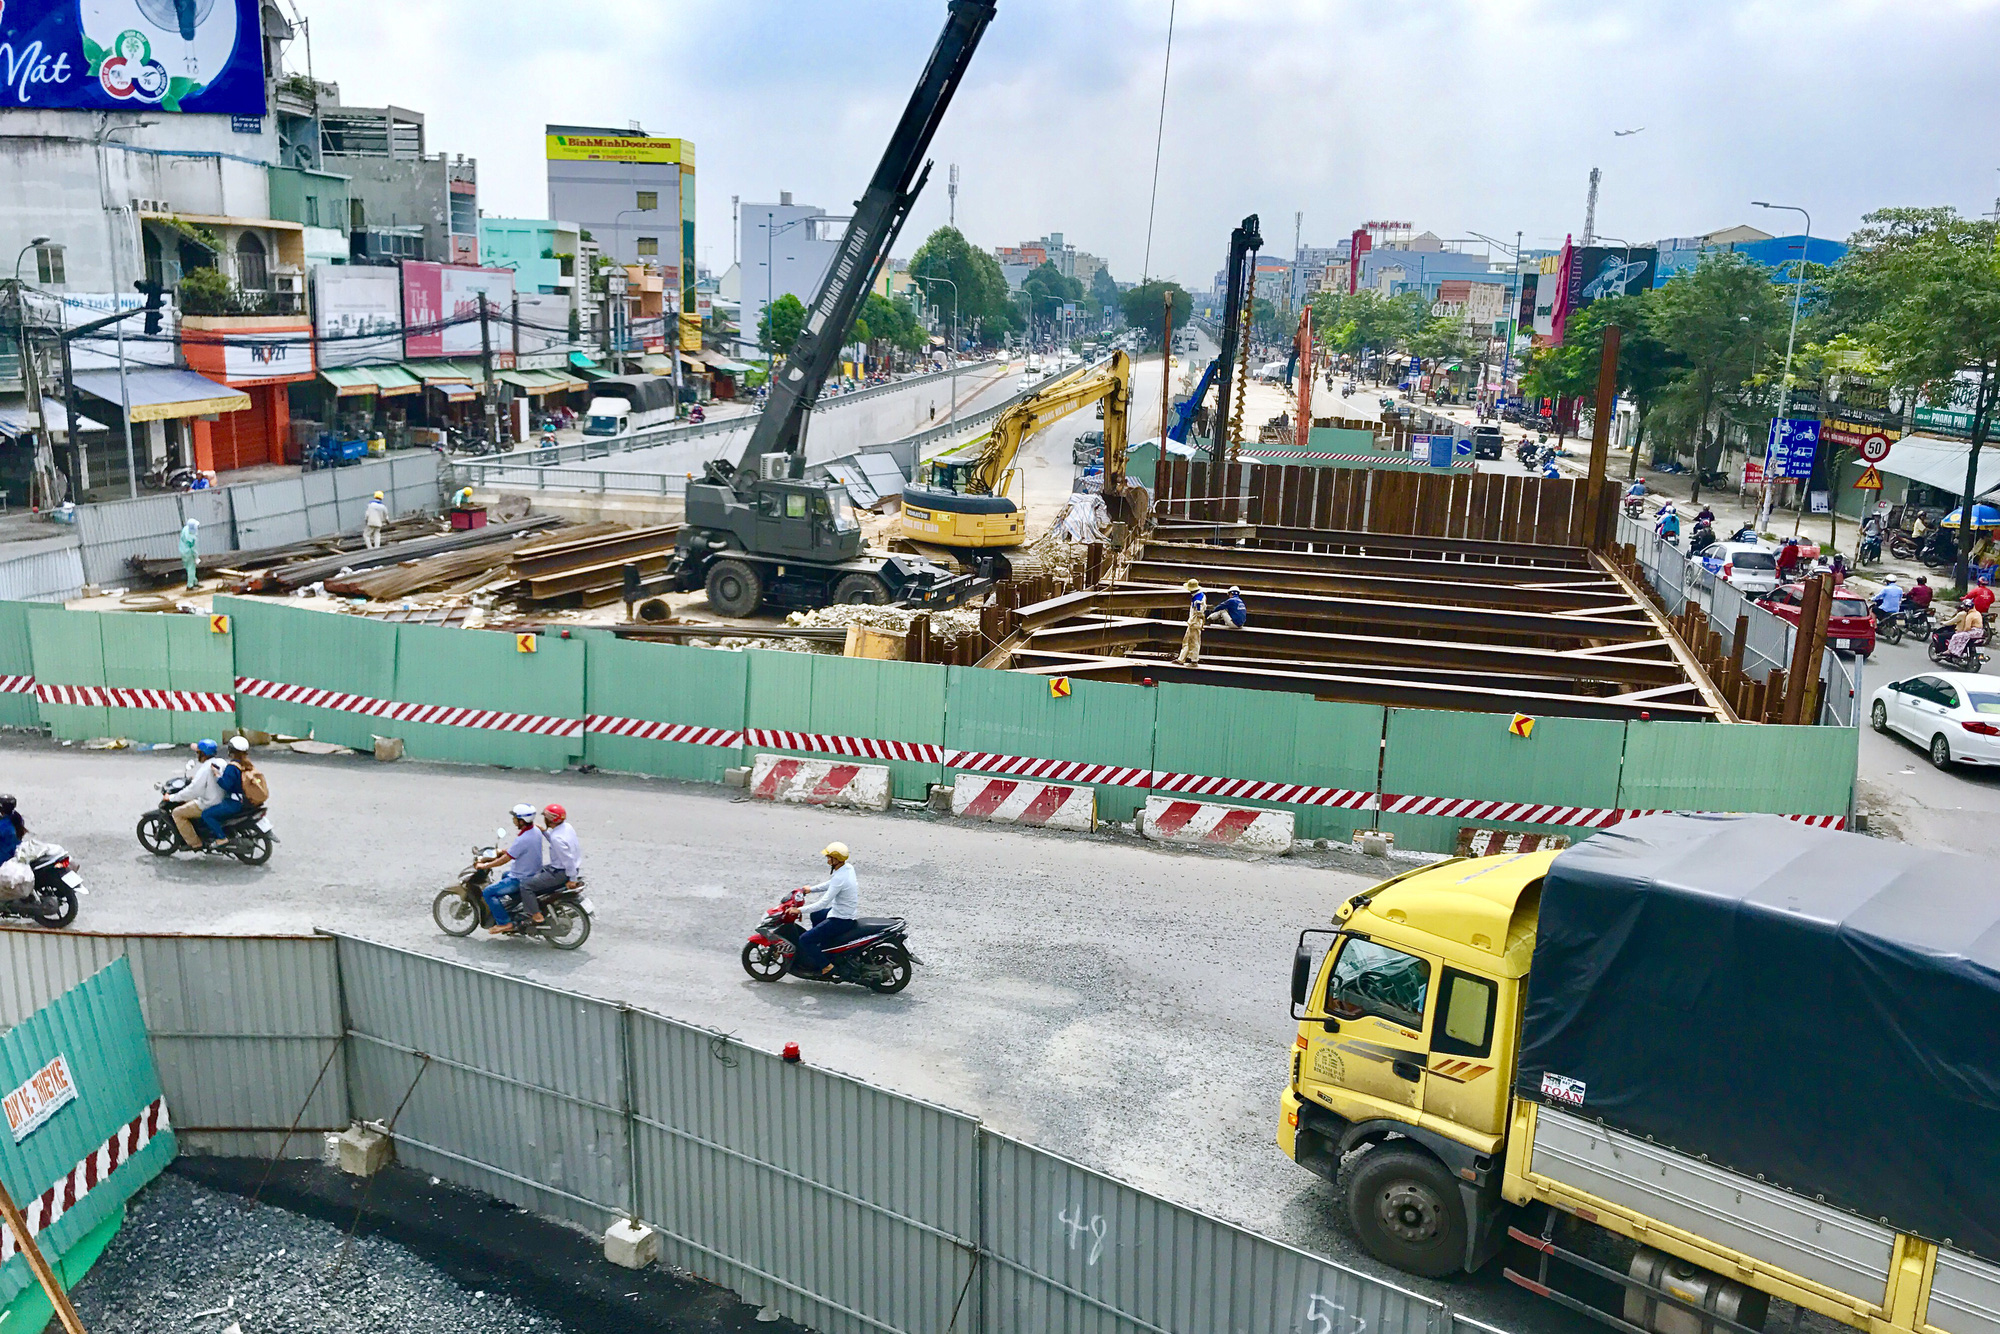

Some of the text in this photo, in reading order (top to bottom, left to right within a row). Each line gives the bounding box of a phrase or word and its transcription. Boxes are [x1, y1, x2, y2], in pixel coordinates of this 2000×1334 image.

[0, 40, 71, 102] Mát
[568, 137, 671, 149] BinhMinhDoor.com
[819, 226, 868, 317] HOÀNG HUY TOÀN
[1569, 245, 1583, 304] FASHION
[252, 346, 287, 365] PROPZY
[1868, 442, 1882, 455] 50
[1059, 1203, 1107, 1266] 48
